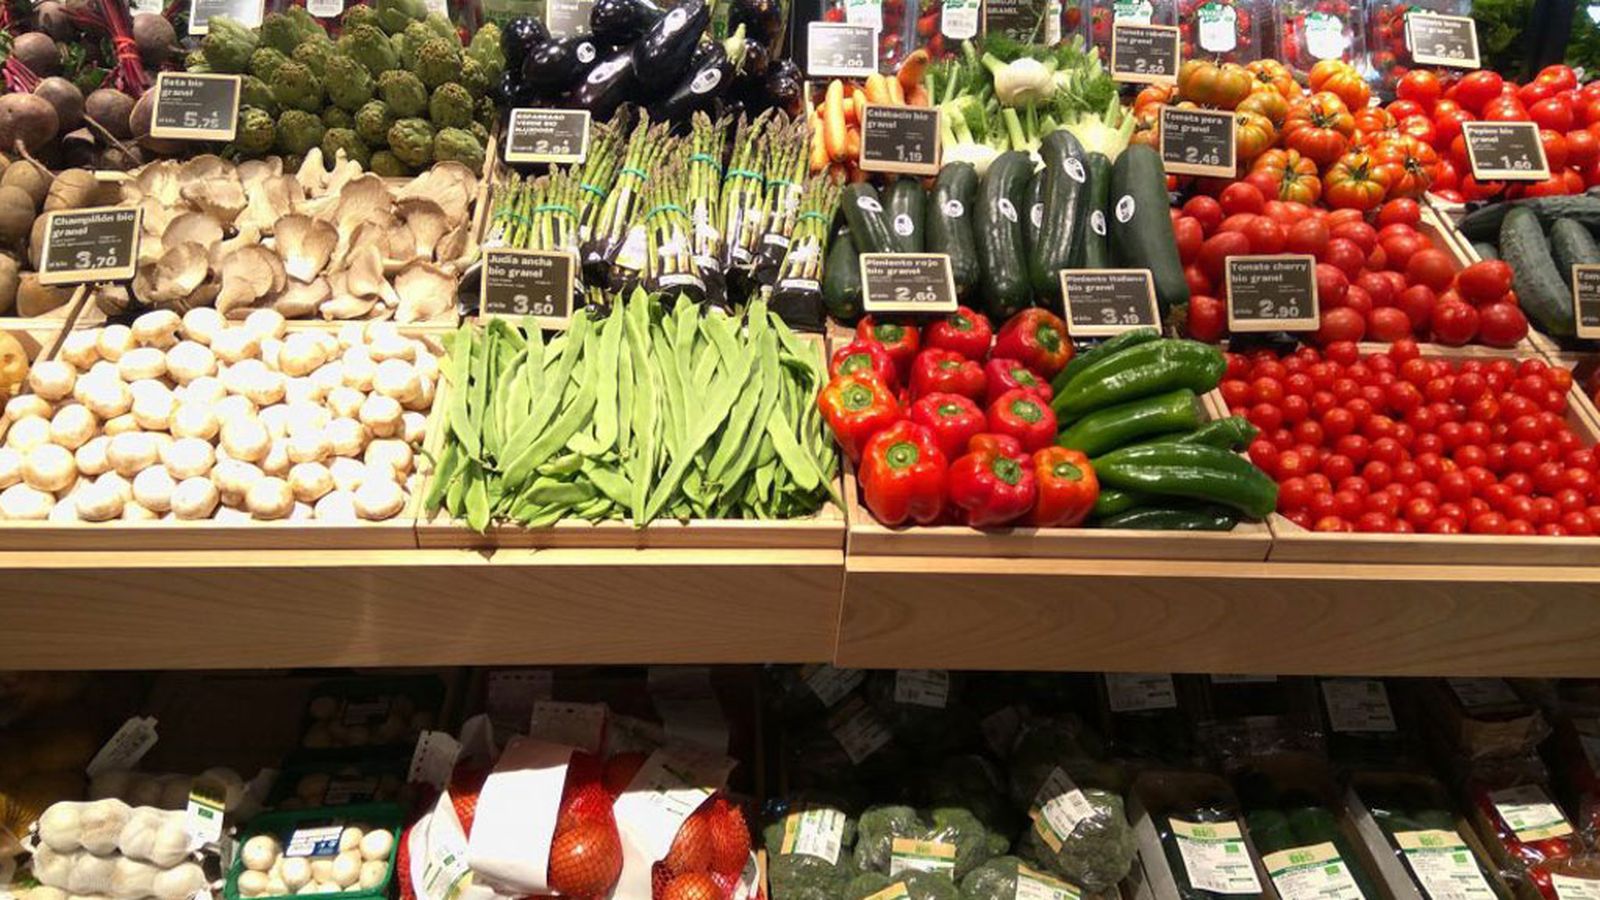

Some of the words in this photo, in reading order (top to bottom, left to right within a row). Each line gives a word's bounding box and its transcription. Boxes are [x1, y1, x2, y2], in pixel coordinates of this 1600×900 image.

[1135, 58, 1165, 74] 2,50
[188, 79, 204, 87] bio
[161, 89, 194, 98] granel
[184, 110, 220, 129] 5,75
[913, 113, 928, 121] bio
[1166, 113, 1199, 123] Tomate
[1201, 116, 1223, 125] pera
[866, 120, 897, 129] granel
[1165, 122, 1179, 130] bio
[1181, 124, 1210, 132] granel
[1470, 136, 1499, 144] granel
[534, 140, 571, 155] 2,99
[895, 144, 923, 162] 1,19
[1185, 146, 1220, 165] 2,49
[1500, 155, 1532, 170] 1,60
[54, 213, 114, 227] Champiñón
[116, 212, 134, 222] bio
[52, 226, 88, 239] granel
[75, 251, 117, 269] 3,70
[521, 257, 553, 267] ancha
[866, 259, 913, 267] Pimiento
[915, 259, 938, 268] rojo
[488, 265, 506, 276] bio
[508, 267, 543, 279] granel
[887, 268, 921, 276] granel
[1231, 262, 1270, 272] Tomate
[1273, 262, 1307, 272] cherry
[1231, 274, 1248, 283] bio
[1250, 274, 1283, 284] granel
[894, 286, 937, 304] 2,60
[1068, 284, 1083, 292] bio
[1085, 284, 1115, 293] granel
[513, 294, 554, 315] 3,50
[1258, 299, 1300, 319] 2,90
[1100, 307, 1140, 325] 3,19
